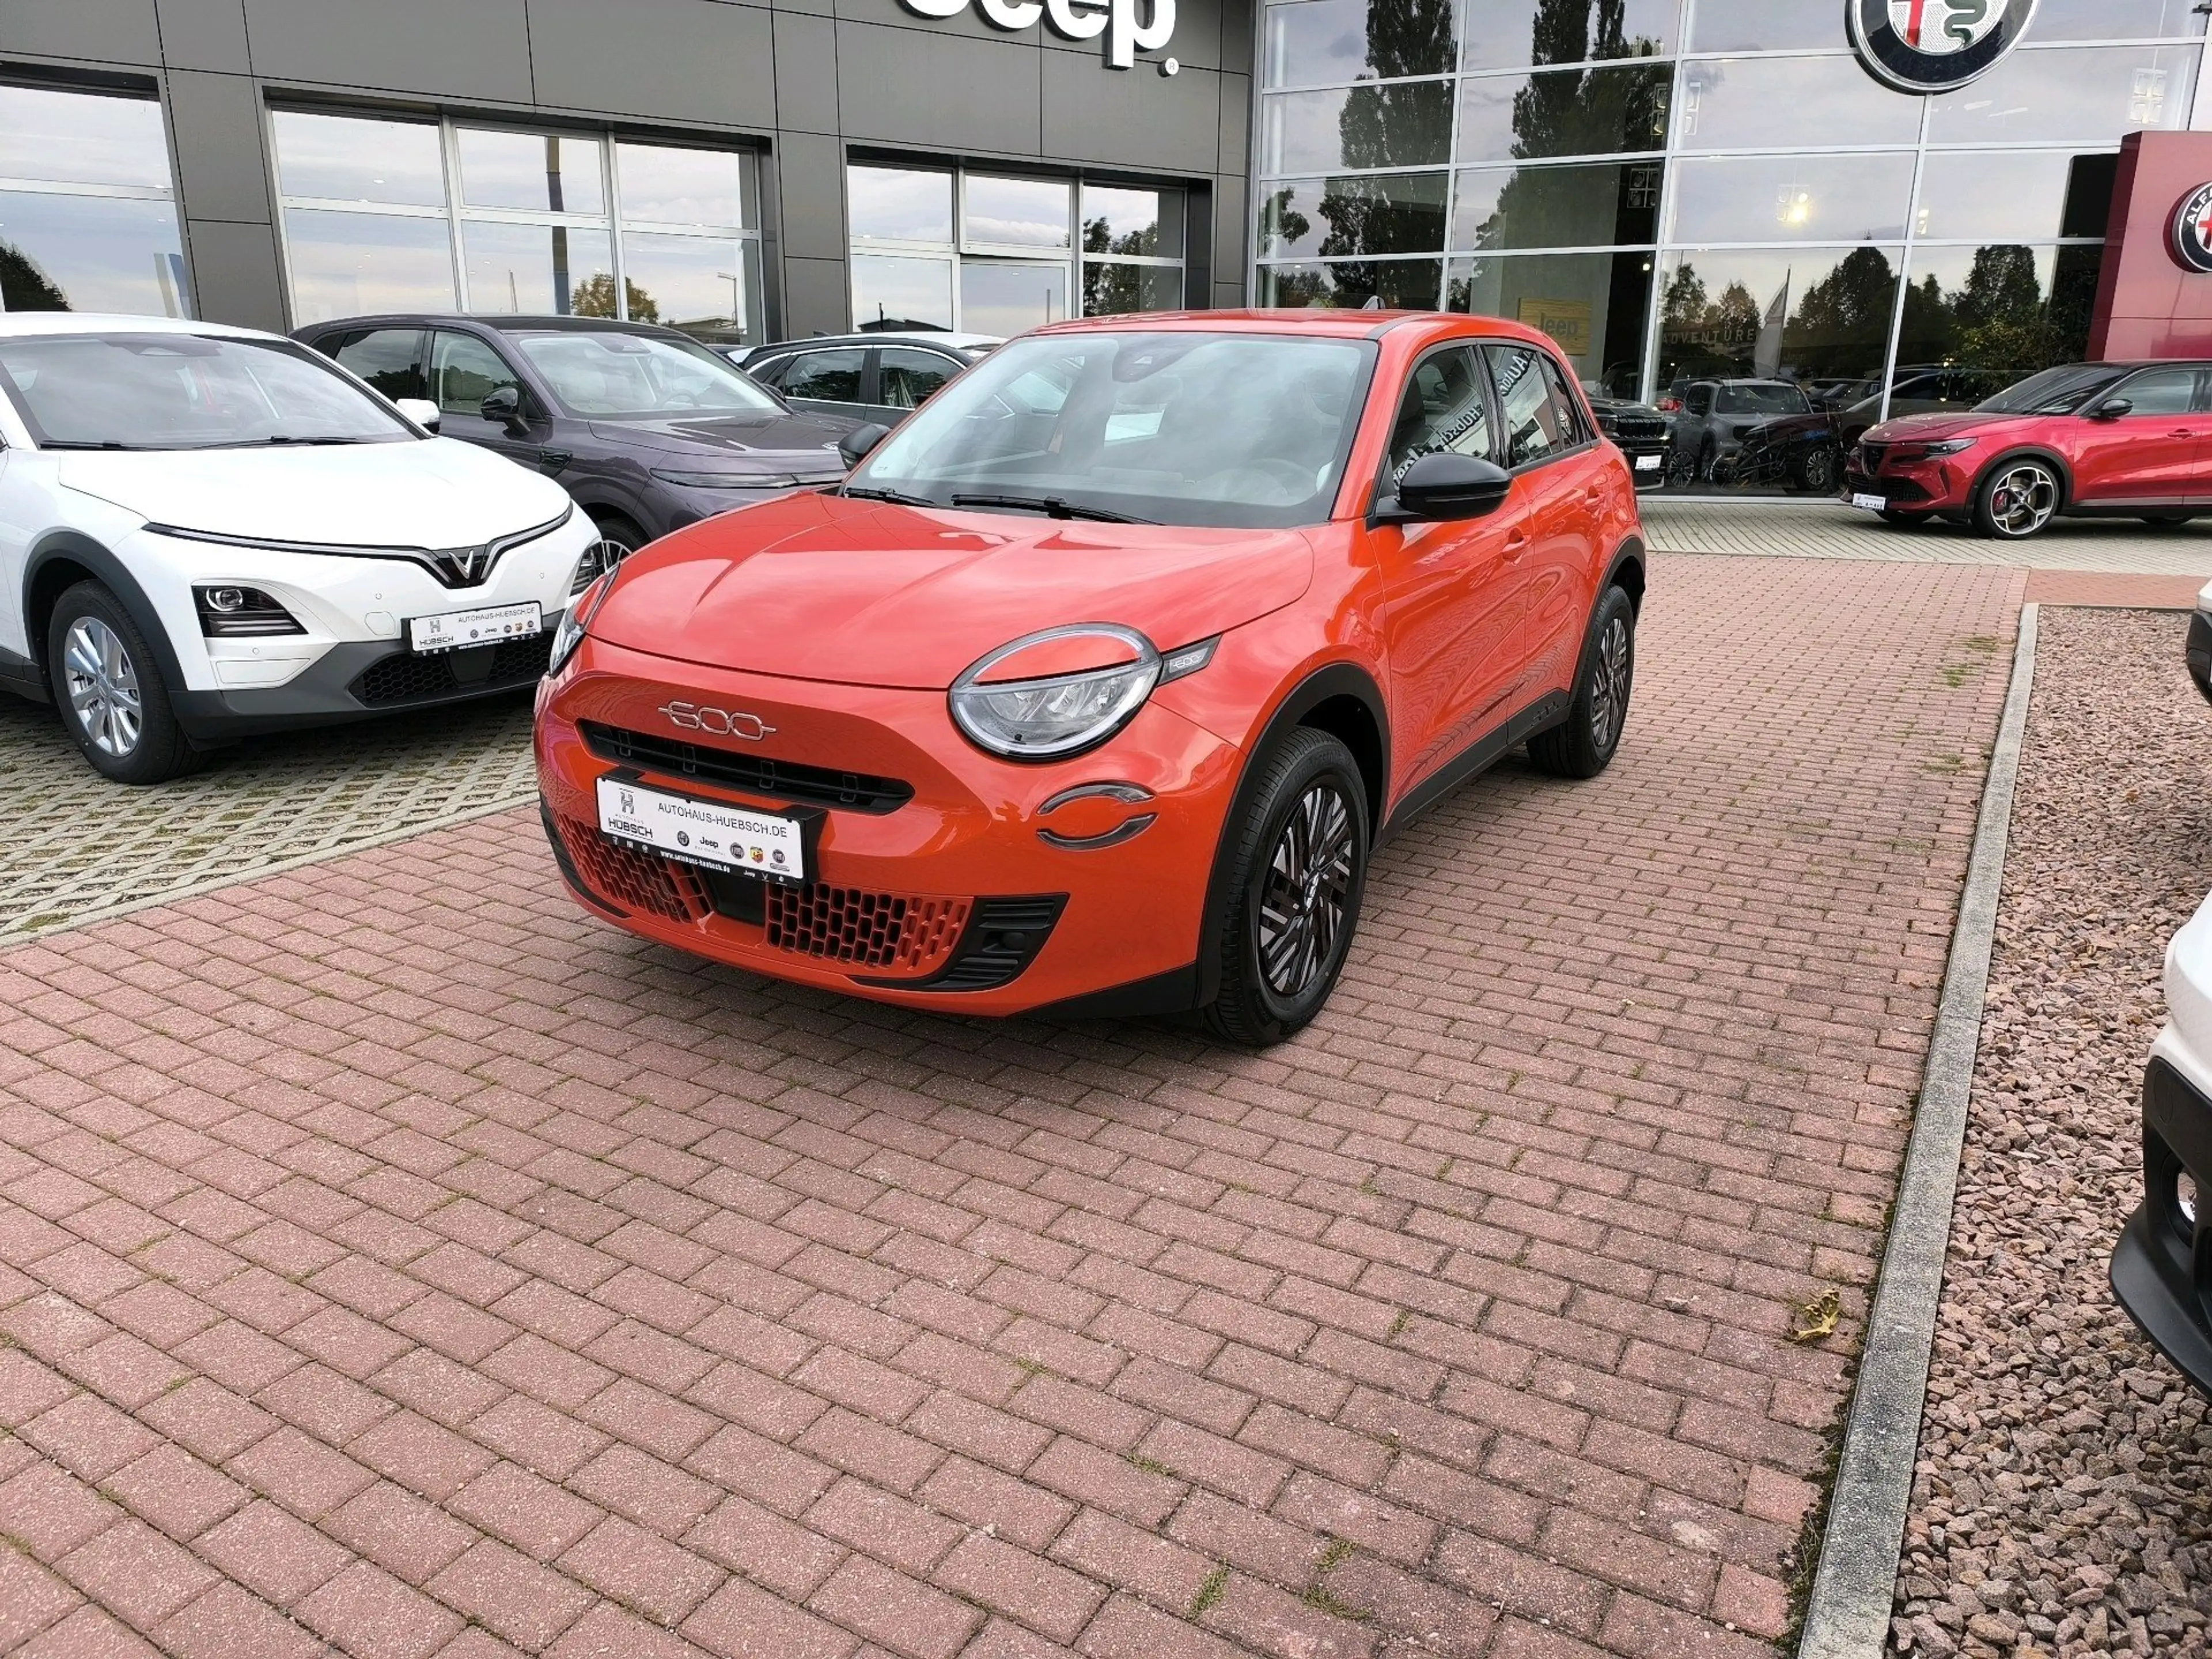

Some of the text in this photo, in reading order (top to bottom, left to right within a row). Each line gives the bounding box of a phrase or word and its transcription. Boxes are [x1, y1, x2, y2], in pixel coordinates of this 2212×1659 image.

[2186, 187, 2212, 225] ALF
[1662, 328, 1755, 344] ADVENTURE
[1173, 655, 1201, 668] 600
[660, 701, 774, 741] 600
[658, 802, 787, 838] AUTOHAUS-HUEBSCH.DE
[699, 836, 719, 849] Jeep
